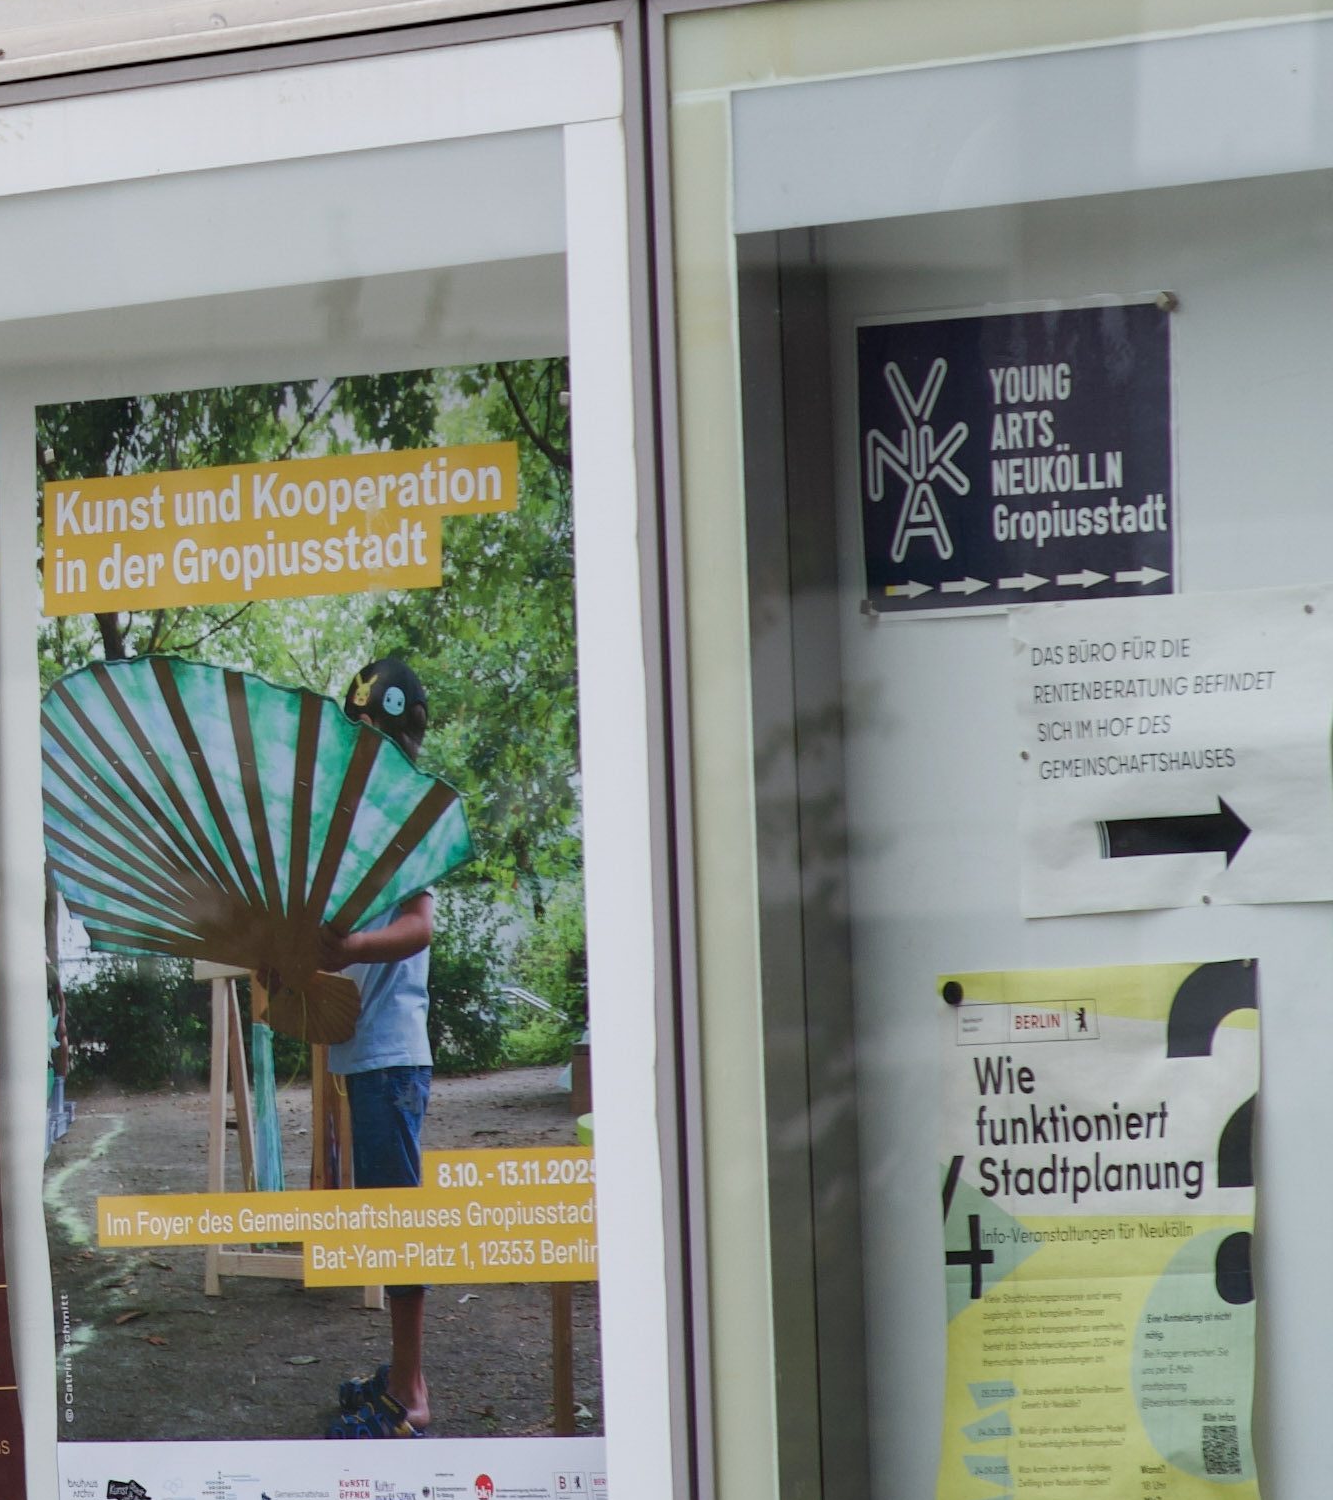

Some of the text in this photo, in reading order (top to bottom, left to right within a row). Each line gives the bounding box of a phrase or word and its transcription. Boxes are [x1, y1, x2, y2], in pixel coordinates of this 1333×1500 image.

[989, 363, 1071, 404] YOUNG
[991, 410, 1054, 450] ARTS
[992, 443, 1123, 496] NEUKÖLLN
[55, 457, 502, 536] Kunst und Kooperation
[993, 493, 1167, 547] Gropiusstadt
[55, 517, 428, 594] in der Gropiusstadt
[1032, 635, 1190, 667] DAS BÜRO FÜR DIE
[1034, 671, 1276, 704] RENTENBERATUNG BEFINDET
[1038, 714, 1171, 742] SICH IM HOF DES
[1041, 748, 1236, 780] GEMEINSCHAFTSHAUSES
[1014, 1013, 1061, 1030] BERLIN
[973, 1056, 1036, 1096] Wie
[976, 1101, 1169, 1146] funktioniert
[437, 1162, 482, 1189] 8.10.
[979, 1151, 1204, 1204] Stadtplanung
[106, 1198, 598, 1241] Im Foyer des Gemeinschaftshauses Gropiusstad
[982, 1220, 1194, 1246] Info-Veranstaltungen für Neukölln
[312, 1243, 456, 1272] Bat-Yam-Platz
[459, 1245, 475, 1271] 1,
[480, 1241, 535, 1268] 12353
[64, 1357, 73, 1404] Catrin
